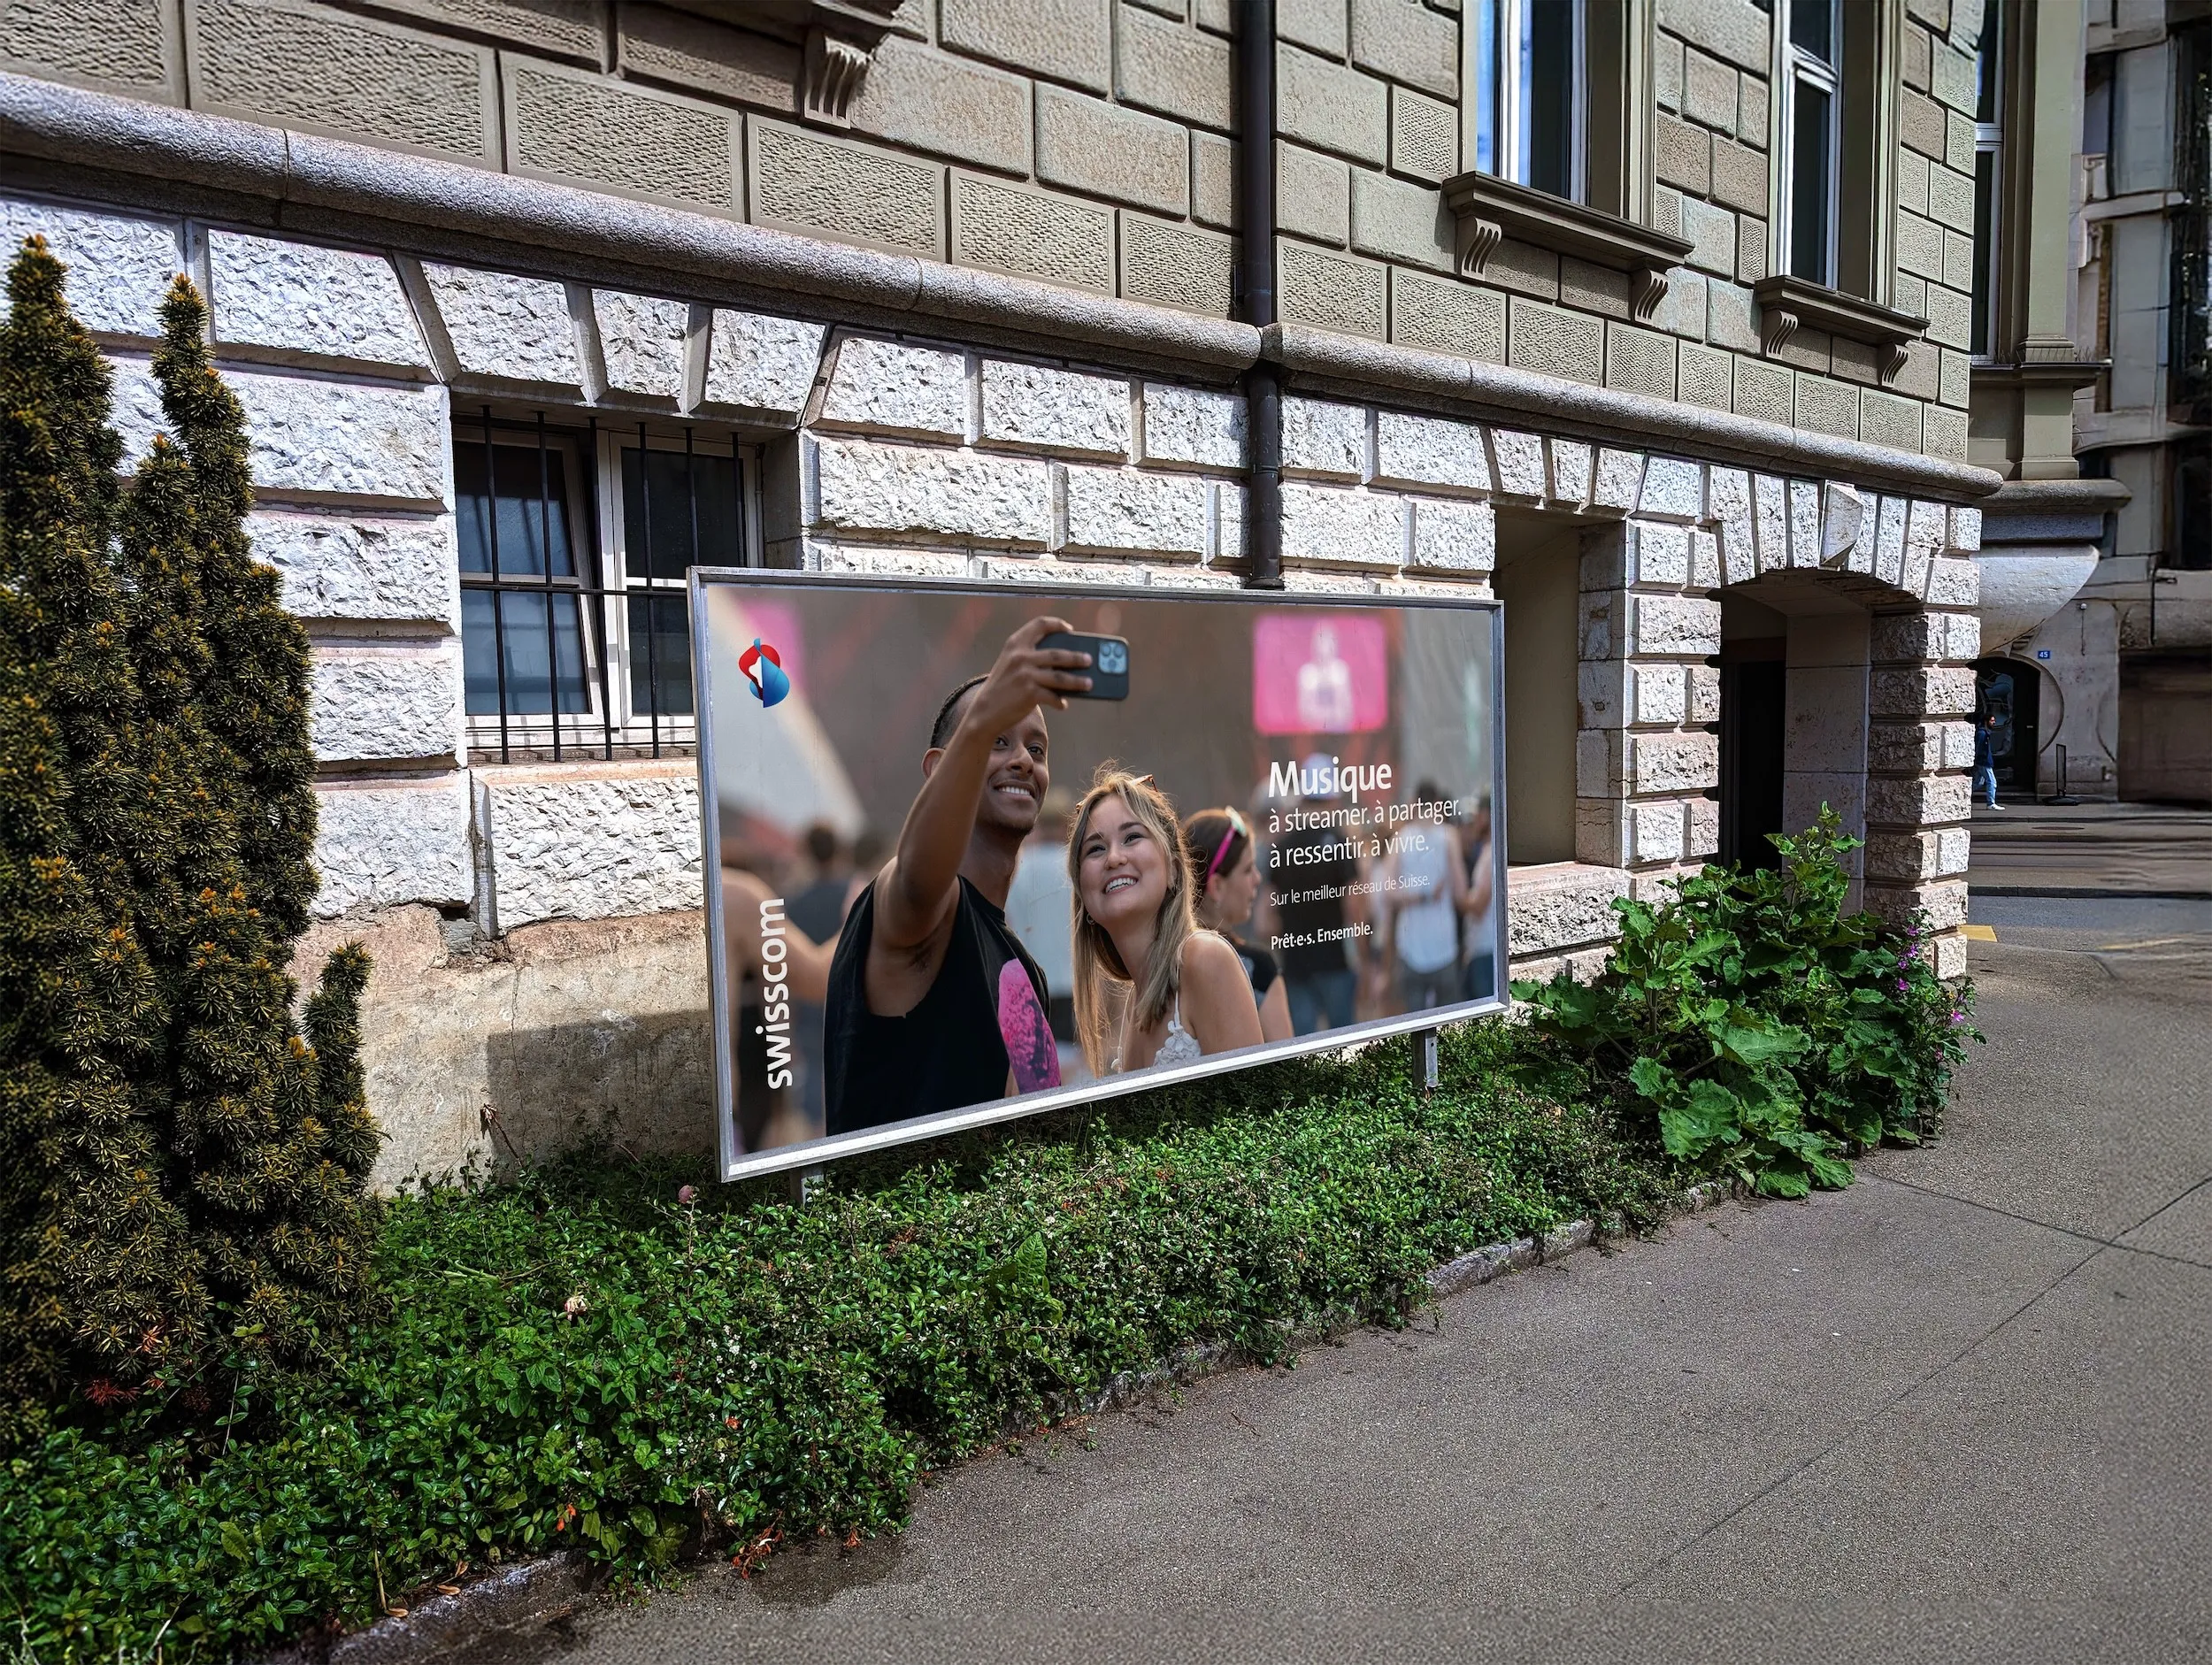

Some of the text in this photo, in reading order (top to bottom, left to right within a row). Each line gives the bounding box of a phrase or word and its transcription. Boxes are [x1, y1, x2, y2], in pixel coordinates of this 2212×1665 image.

[1268, 756, 1393, 803] Musique
[1269, 796, 1462, 833] à streamer. à partager.
[1269, 830, 1430, 869] à ressentir. à vivre.
[1270, 873, 1430, 906] Sur le meilleur réseau de Suisse.
[1317, 922, 1373, 943] Ensemble.
[755, 898, 793, 1090] swisscom
